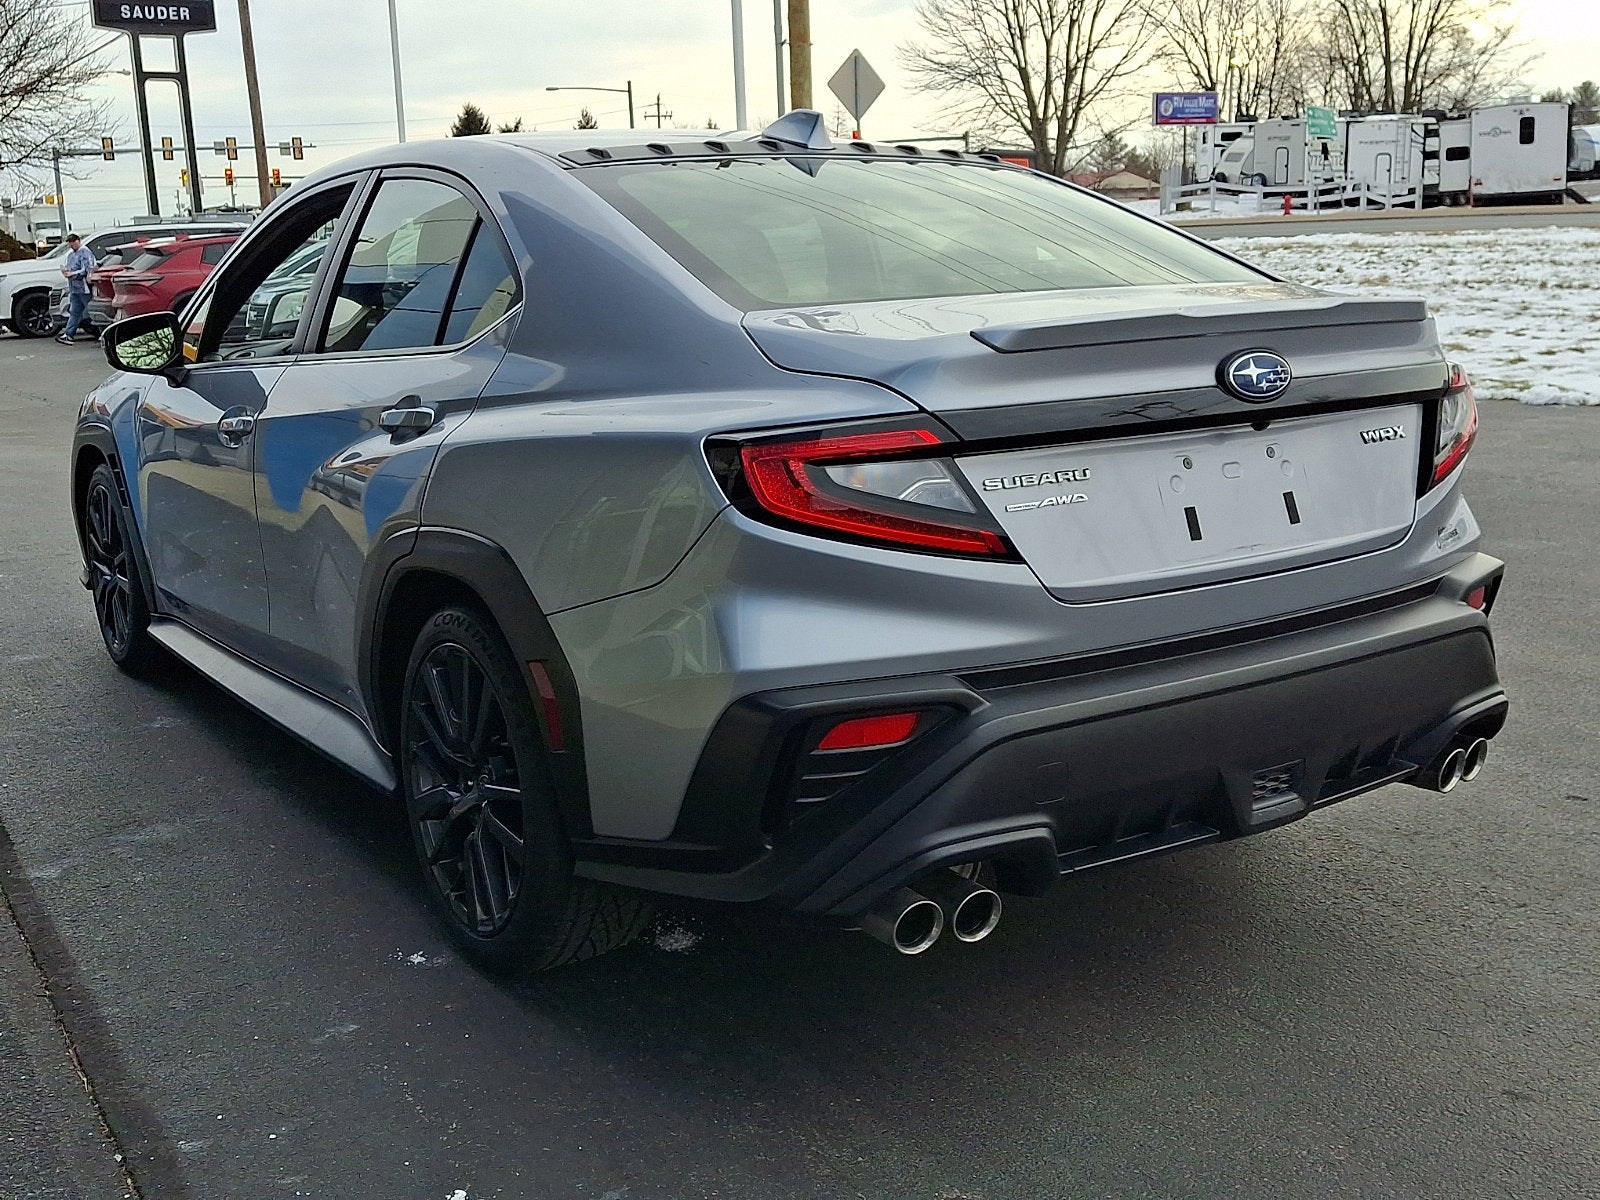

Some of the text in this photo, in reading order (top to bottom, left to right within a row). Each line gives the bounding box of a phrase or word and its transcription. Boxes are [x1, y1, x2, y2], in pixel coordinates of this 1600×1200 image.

[120, 4, 190, 20] SAUDER
[1173, 96, 1184, 108] RV
[1360, 425, 1406, 444] WRX
[983, 468, 1091, 491] SUBARU
[1039, 493, 1089, 508] AWD
